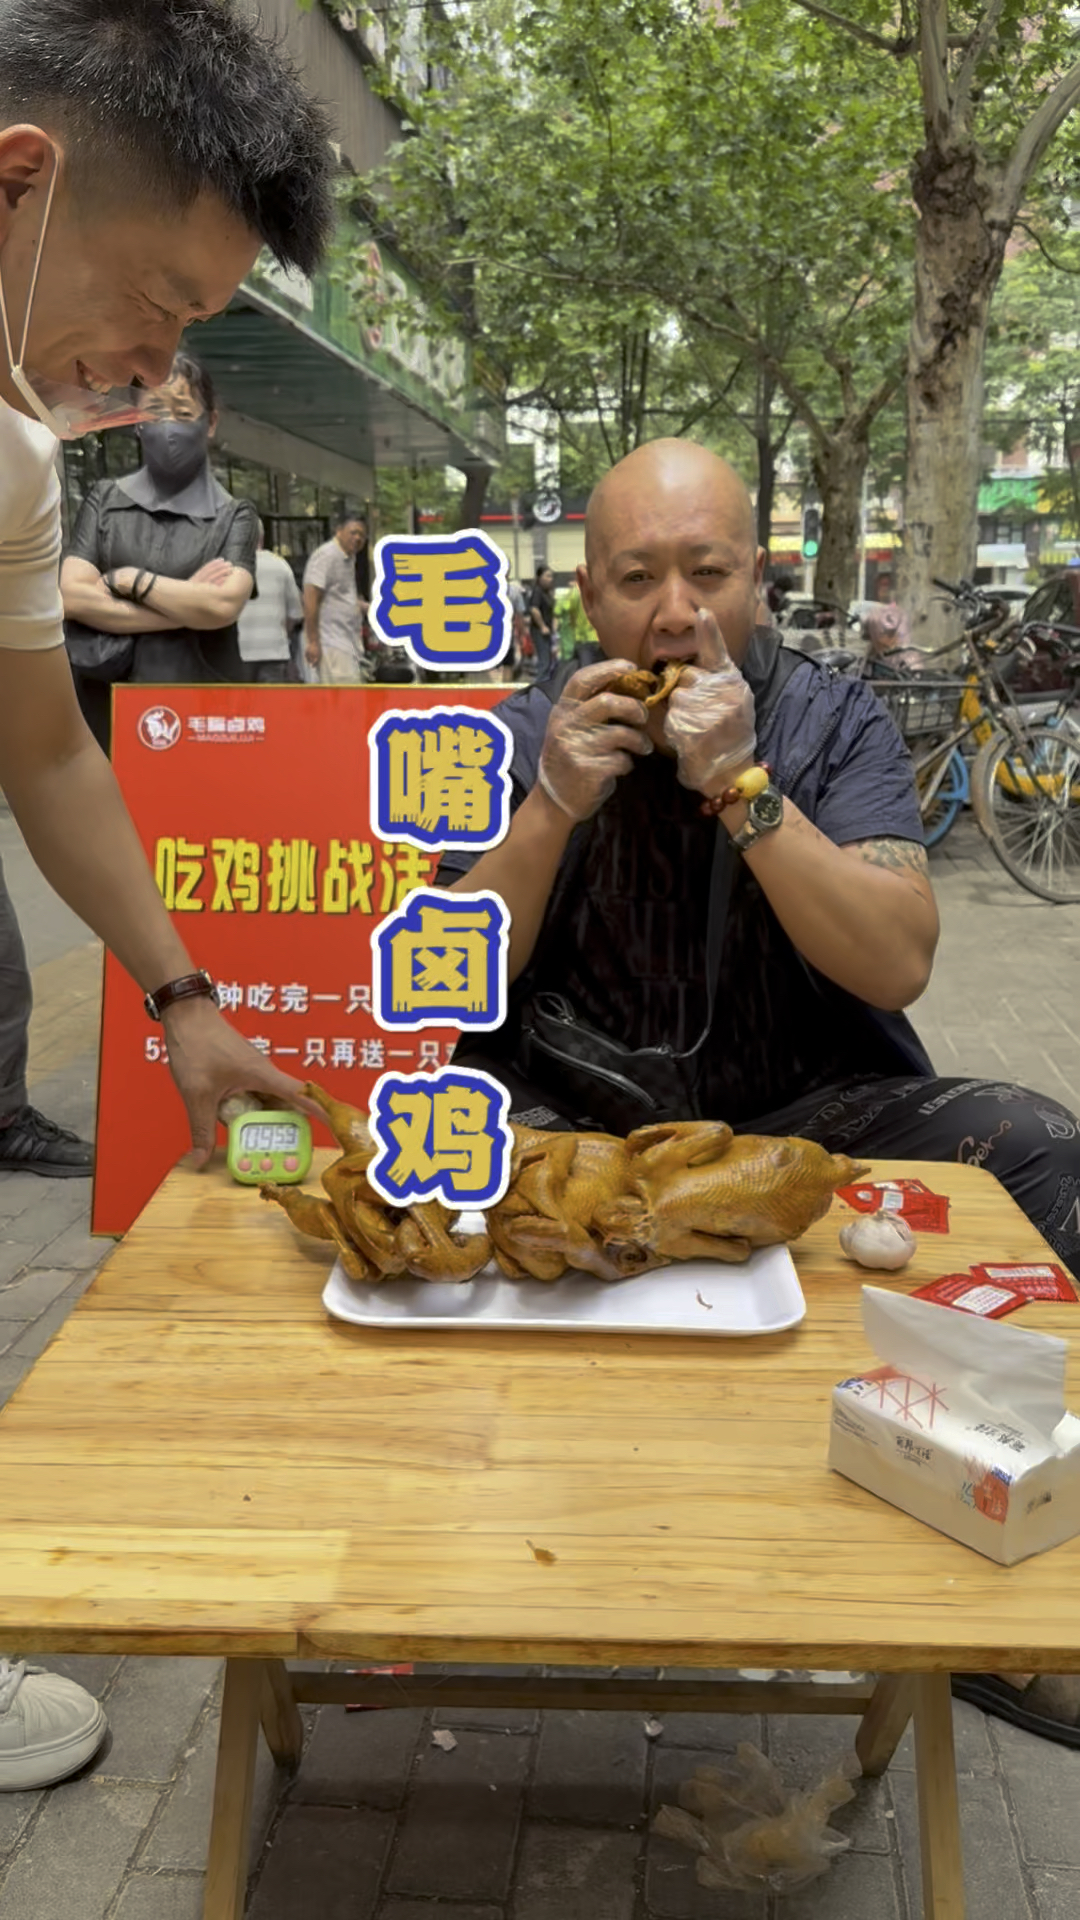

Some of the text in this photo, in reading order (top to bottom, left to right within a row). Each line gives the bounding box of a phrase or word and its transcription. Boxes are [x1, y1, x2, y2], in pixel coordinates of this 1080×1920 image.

[155, 837, 432, 914] 吃鸡挑战活
